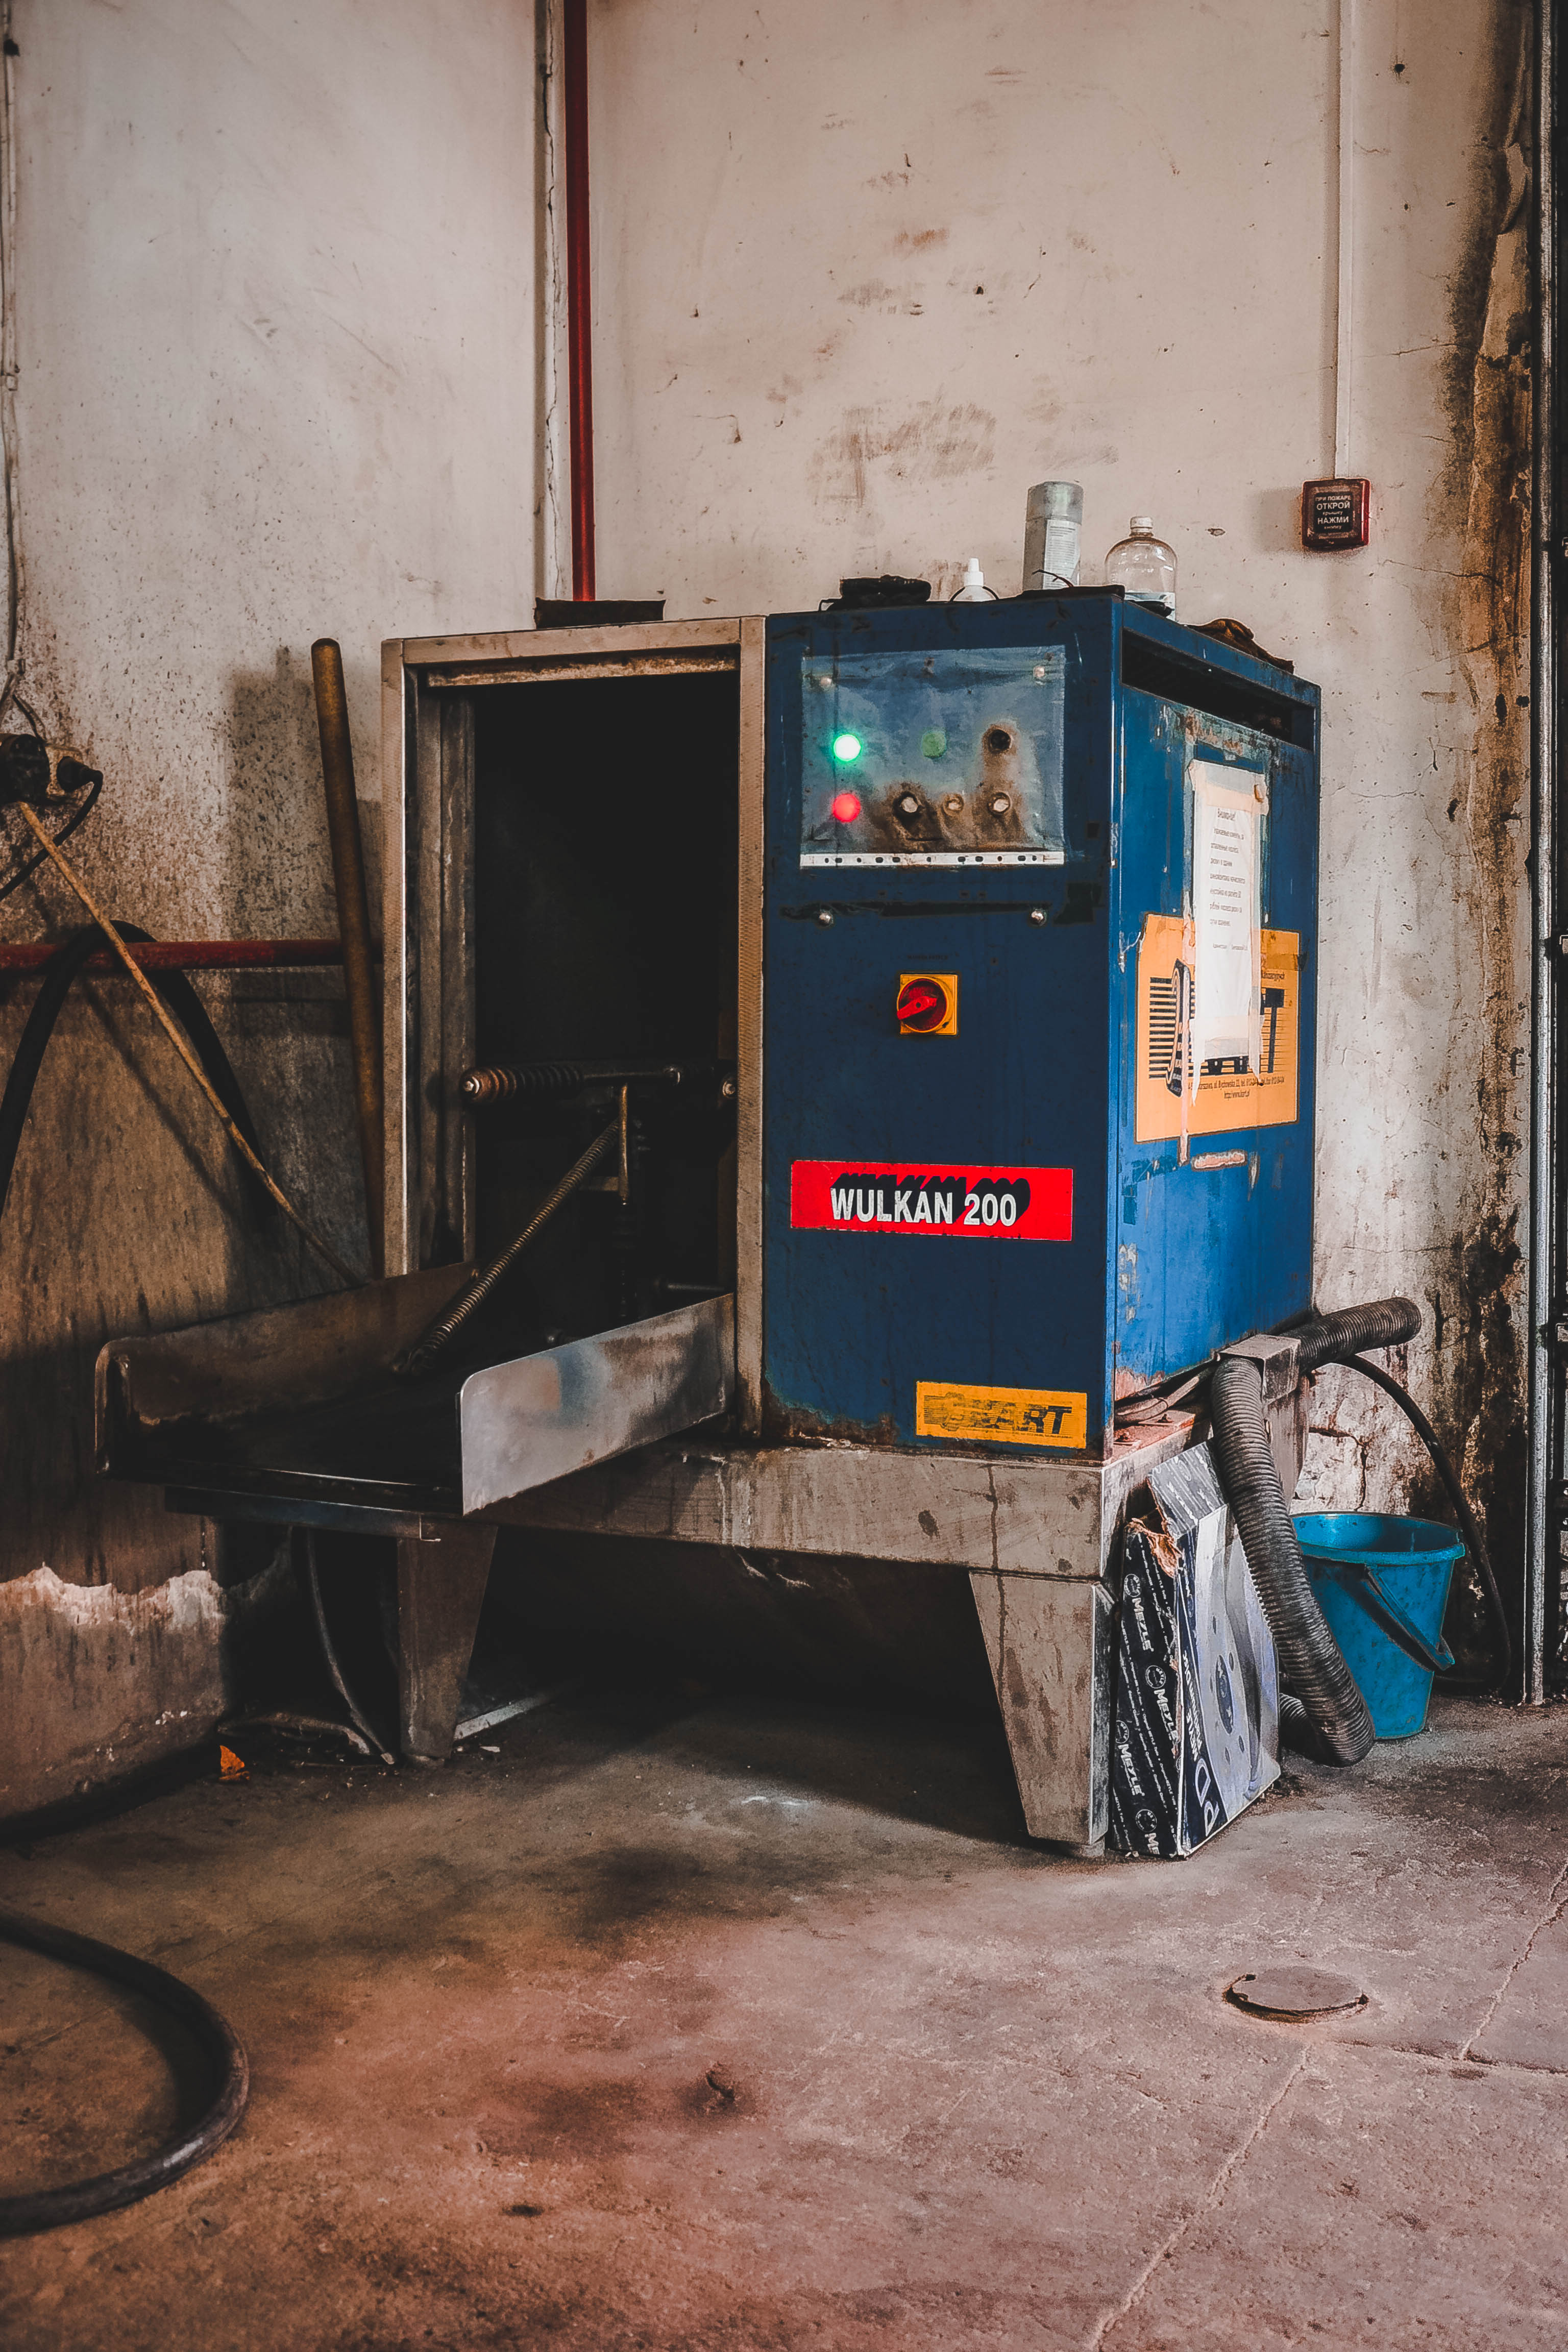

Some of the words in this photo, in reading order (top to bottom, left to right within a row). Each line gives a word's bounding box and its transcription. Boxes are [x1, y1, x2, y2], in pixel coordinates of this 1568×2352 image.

[1317, 501, 1350, 510] ОТКРОЙ
[1317, 516, 1349, 525] НАЖМИ
[830, 1188, 952, 1224] WULKAN
[964, 1193, 1017, 1226] 200
[1132, 1598, 1152, 1649] MEYLE
[1154, 1688, 1179, 1740] MEYLE
[1186, 1708, 1198, 1761] MEYLE
[1188, 1683, 1203, 1752] Platinum
[1118, 1744, 1142, 1795] MEYLE
[1195, 1757, 1220, 1837] PD
